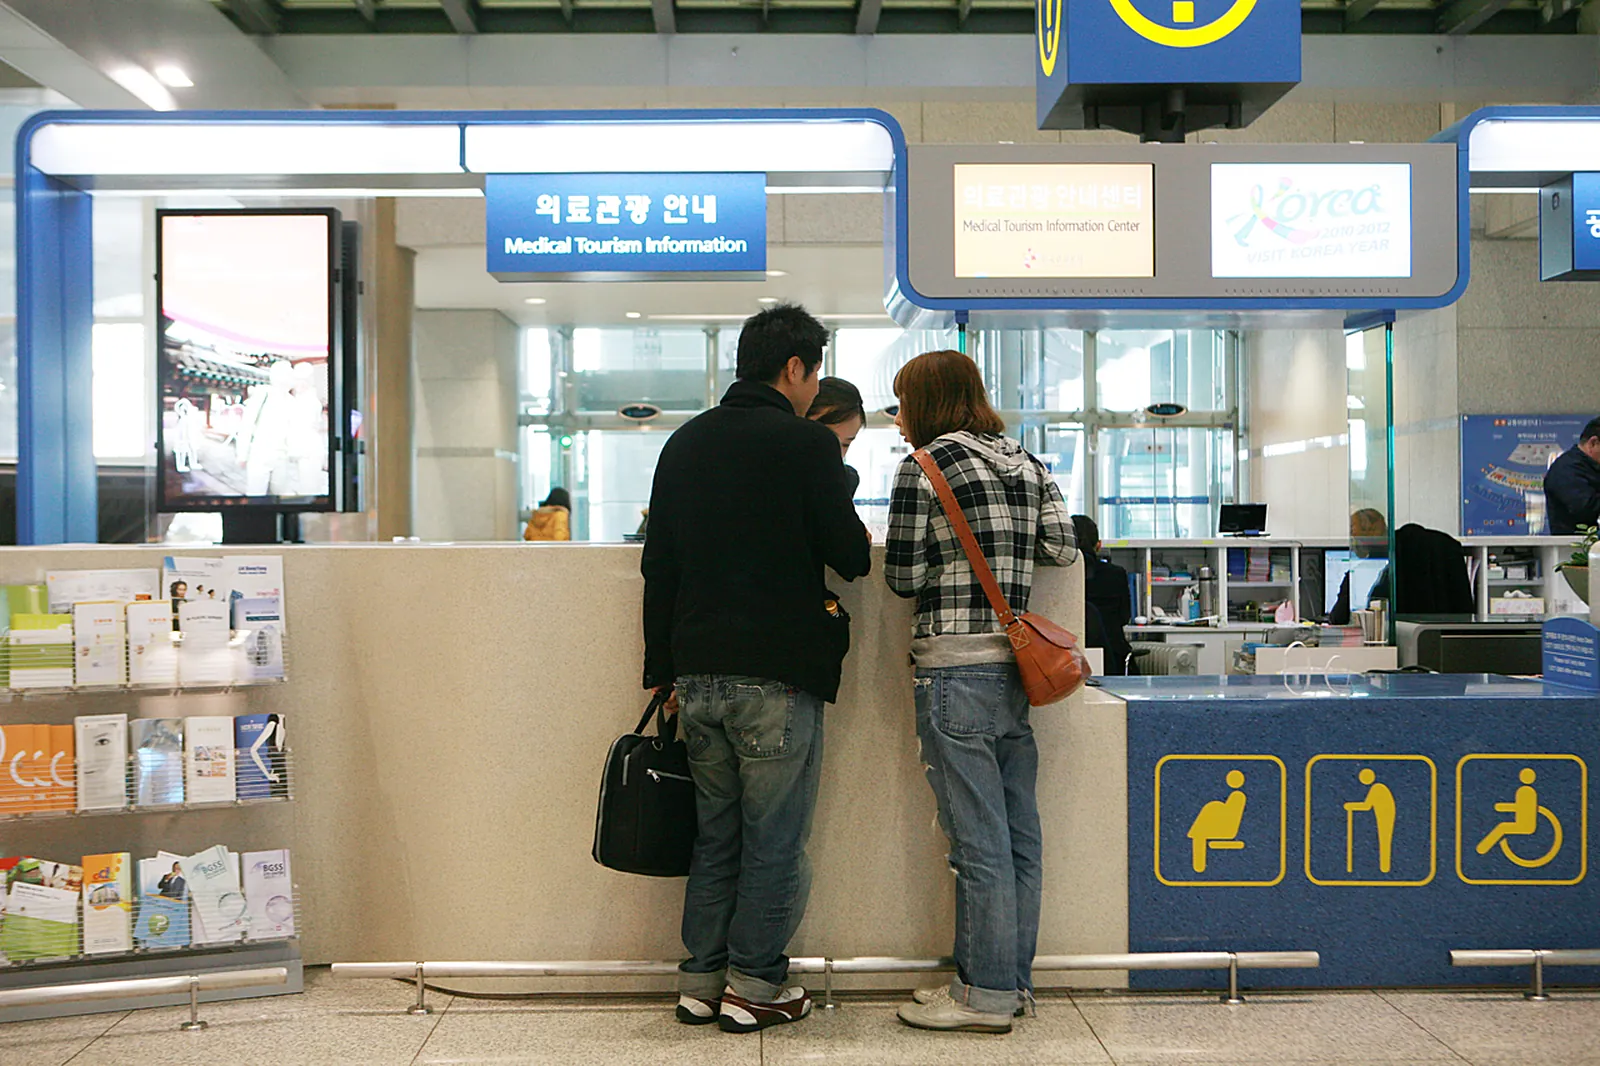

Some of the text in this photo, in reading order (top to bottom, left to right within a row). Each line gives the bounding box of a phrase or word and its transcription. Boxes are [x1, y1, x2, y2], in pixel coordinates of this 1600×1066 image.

[535, 193, 717, 225] 의료관광 안내
[963, 219, 1141, 232] Medical Tourism Information Center
[504, 235, 748, 254] Medical Tourism Information
[1247, 238, 1390, 264] VISIT KOREA YEAR
